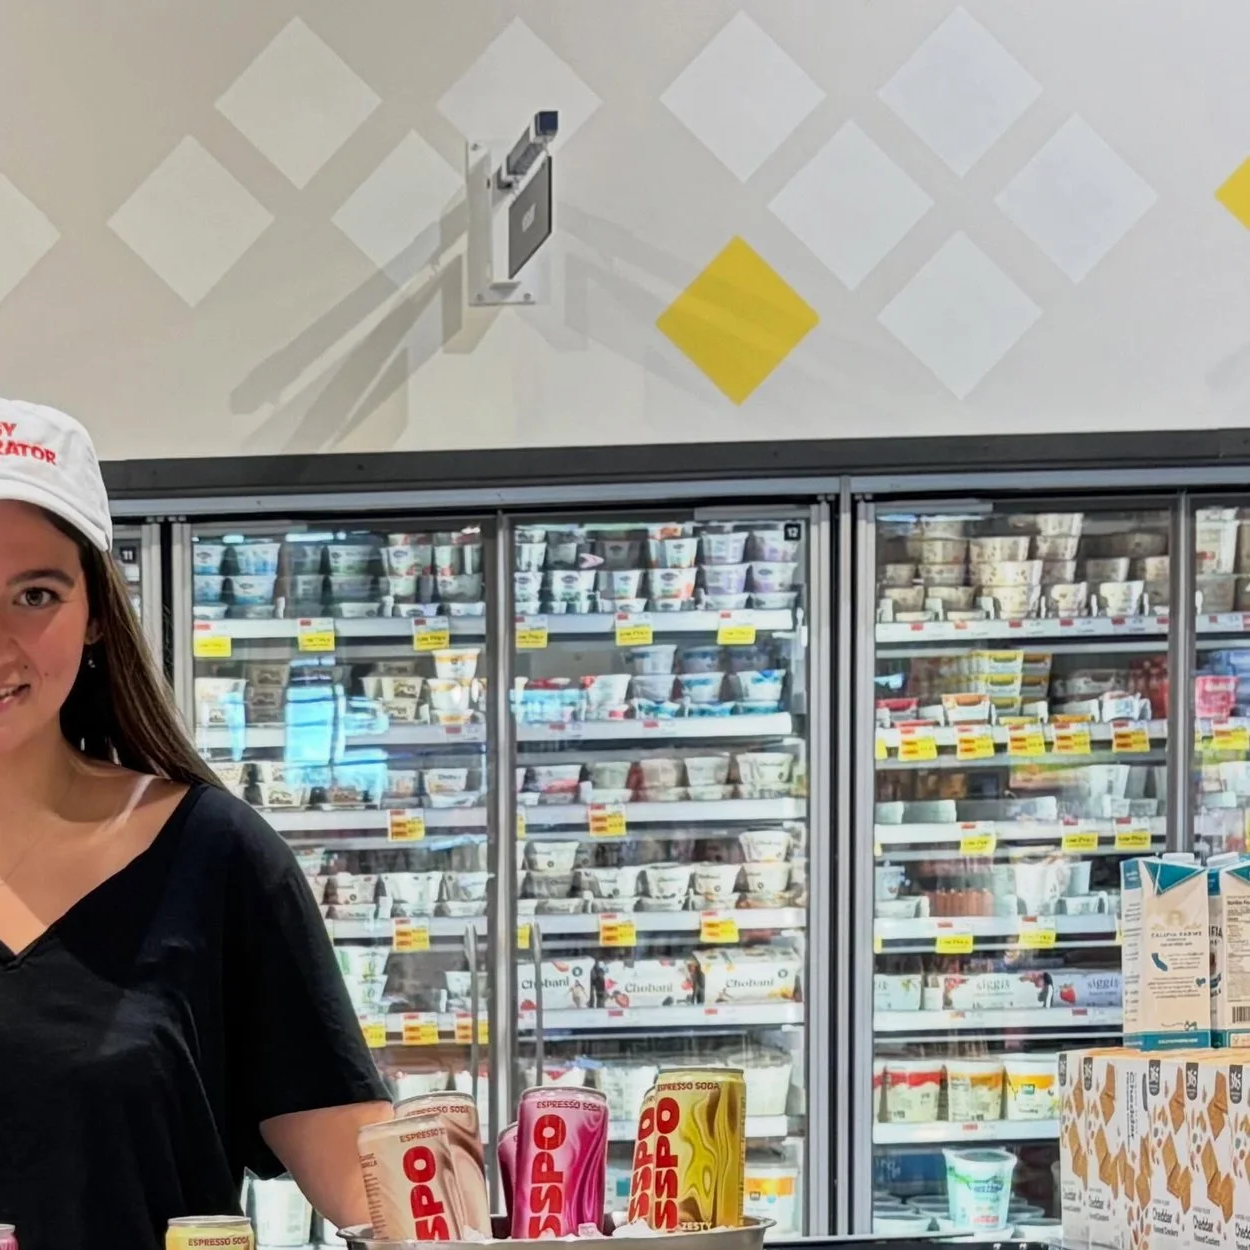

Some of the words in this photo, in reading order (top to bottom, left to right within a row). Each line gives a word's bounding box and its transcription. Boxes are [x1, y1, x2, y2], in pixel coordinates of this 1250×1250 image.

[787, 526, 798, 538] 12
[521, 975, 569, 990] Chbani
[624, 981, 673, 994] Chobani
[658, 1082, 693, 1091] ESPRESSO
[695, 1082, 720, 1090] SODA
[536, 1100, 580, 1109] ESPRESSO
[399, 1128, 440, 1143] ESPRESSO
[627, 1107, 655, 1223] SSPO
[655, 1097, 680, 1229] SSPO
[528, 1114, 567, 1239] SSPO
[402, 1145, 450, 1240] SPO
[1153, 1207, 1173, 1223] Cheddar
[681, 1221, 712, 1231] ZESTY
[1193, 1215, 1213, 1232] Cheddar
[188, 1238, 230, 1246] ESPRESSO
